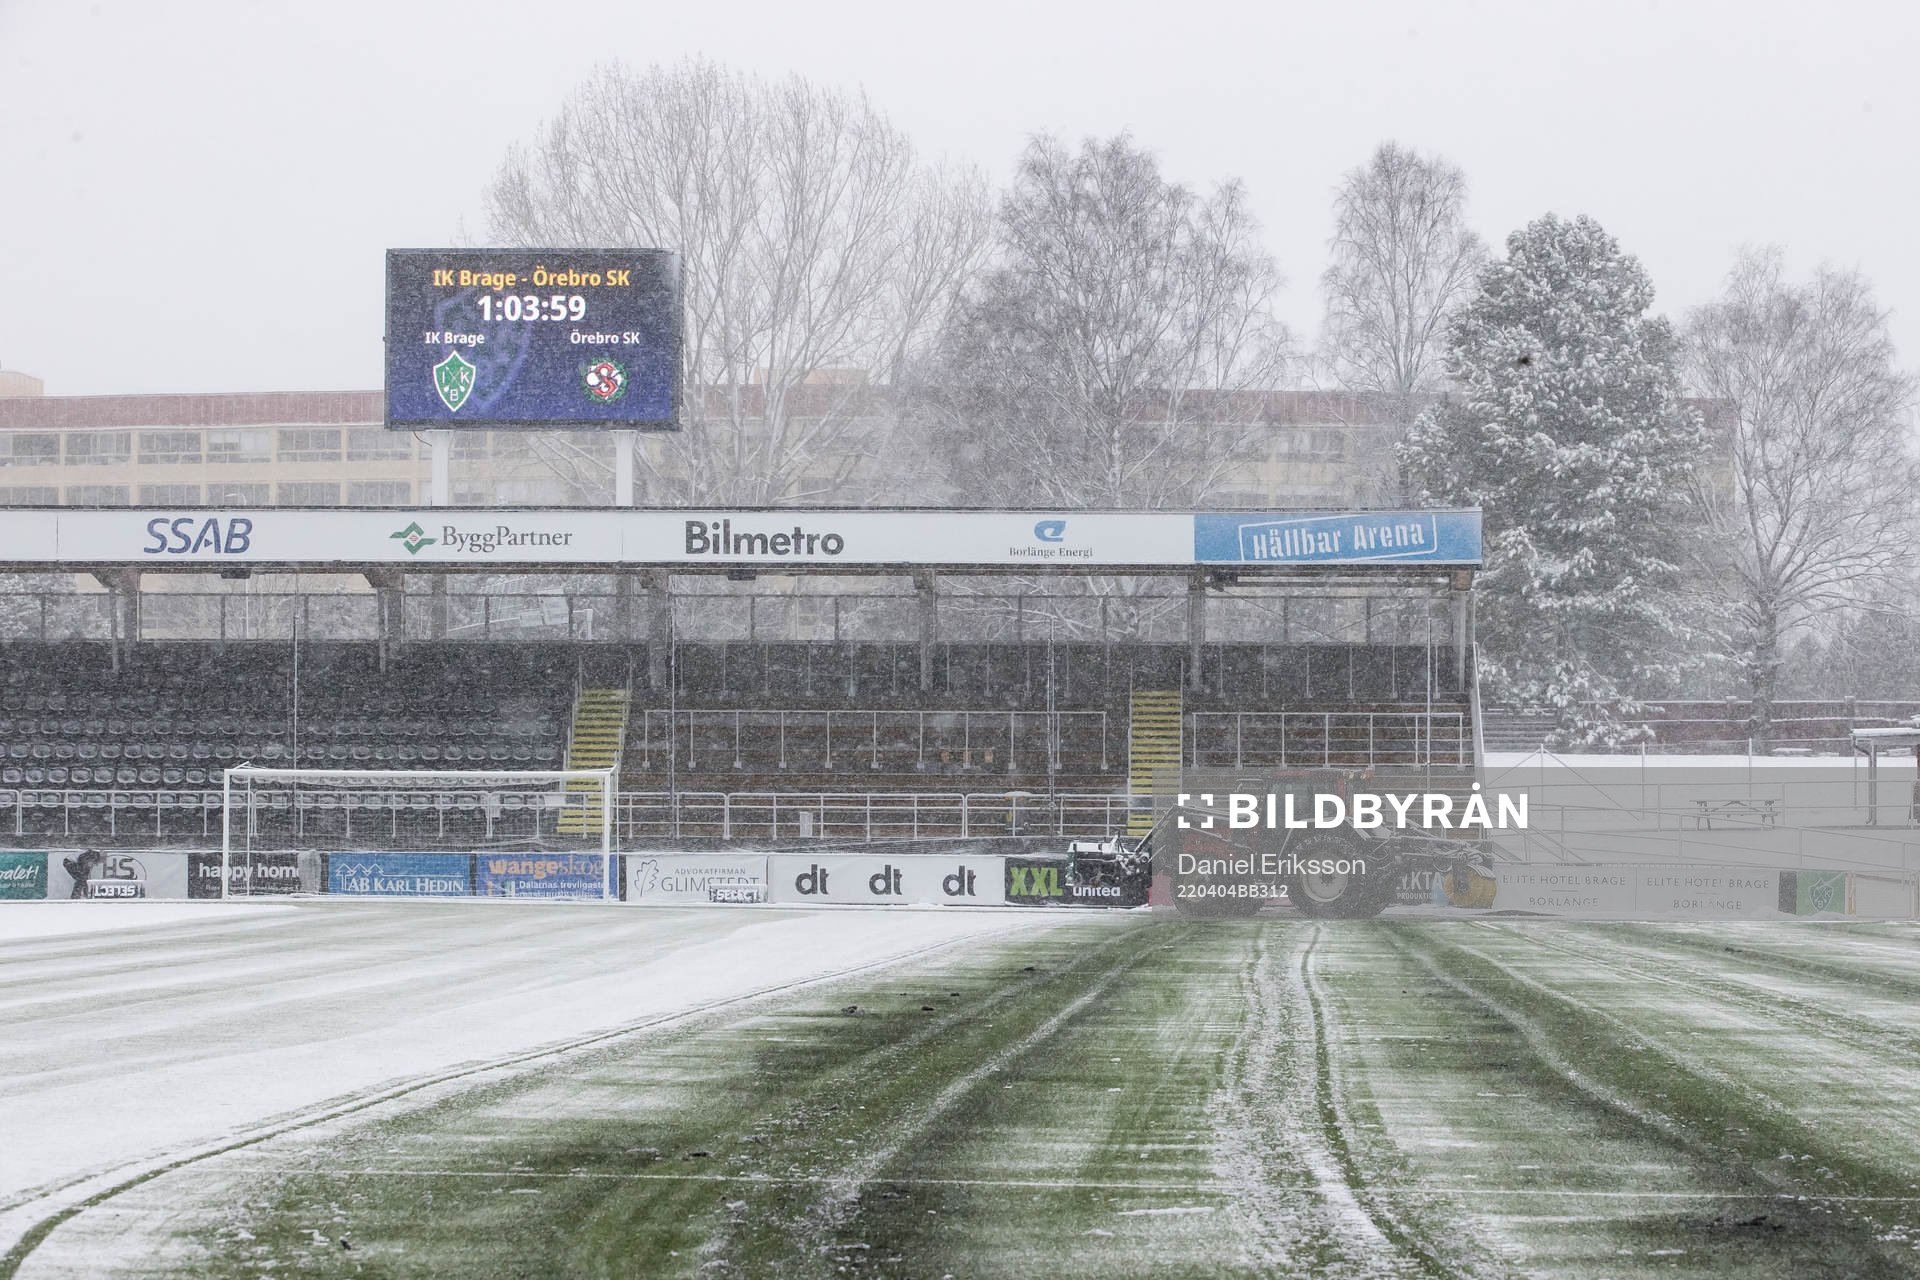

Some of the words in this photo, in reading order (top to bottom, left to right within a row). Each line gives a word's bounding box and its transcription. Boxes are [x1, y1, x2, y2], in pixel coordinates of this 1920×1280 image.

[432, 269, 454, 286] IK
[459, 269, 517, 291] Brage
[533, 265, 601, 286] Örebro
[605, 269, 631, 286] SK
[477, 295, 586, 322] 1:03:59
[425, 331, 441, 345] IK
[444, 331, 486, 348] Brage
[570, 329, 620, 345] Örebro
[622, 331, 641, 345] SK
[143, 517, 253, 554] SSAB
[441, 525, 573, 553] ByggPartner
[685, 518, 845, 556] Bilmetro
[1253, 528, 1341, 560] Hällbar
[1353, 523, 1425, 551] Arena
[1009, 547, 1056, 558] Borlänge
[1059, 547, 1093, 558] Energi
[257, 862, 300, 878] hom
[795, 863, 830, 895] dt
[868, 864, 903, 896] dt
[942, 865, 977, 897] dt
[1010, 867, 1064, 896] XXL
[1396, 872, 1443, 890] YKTA
[1540, 875, 1580, 885] HOTEL
[1585, 876, 1627, 886] BRAGE
[1647, 877, 1680, 887] ELITE
[1728, 880, 1770, 889] BRAGE
[348, 878, 370, 892] AB
[373, 878, 411, 892] KARL
[416, 878, 464, 893] HEDIN
